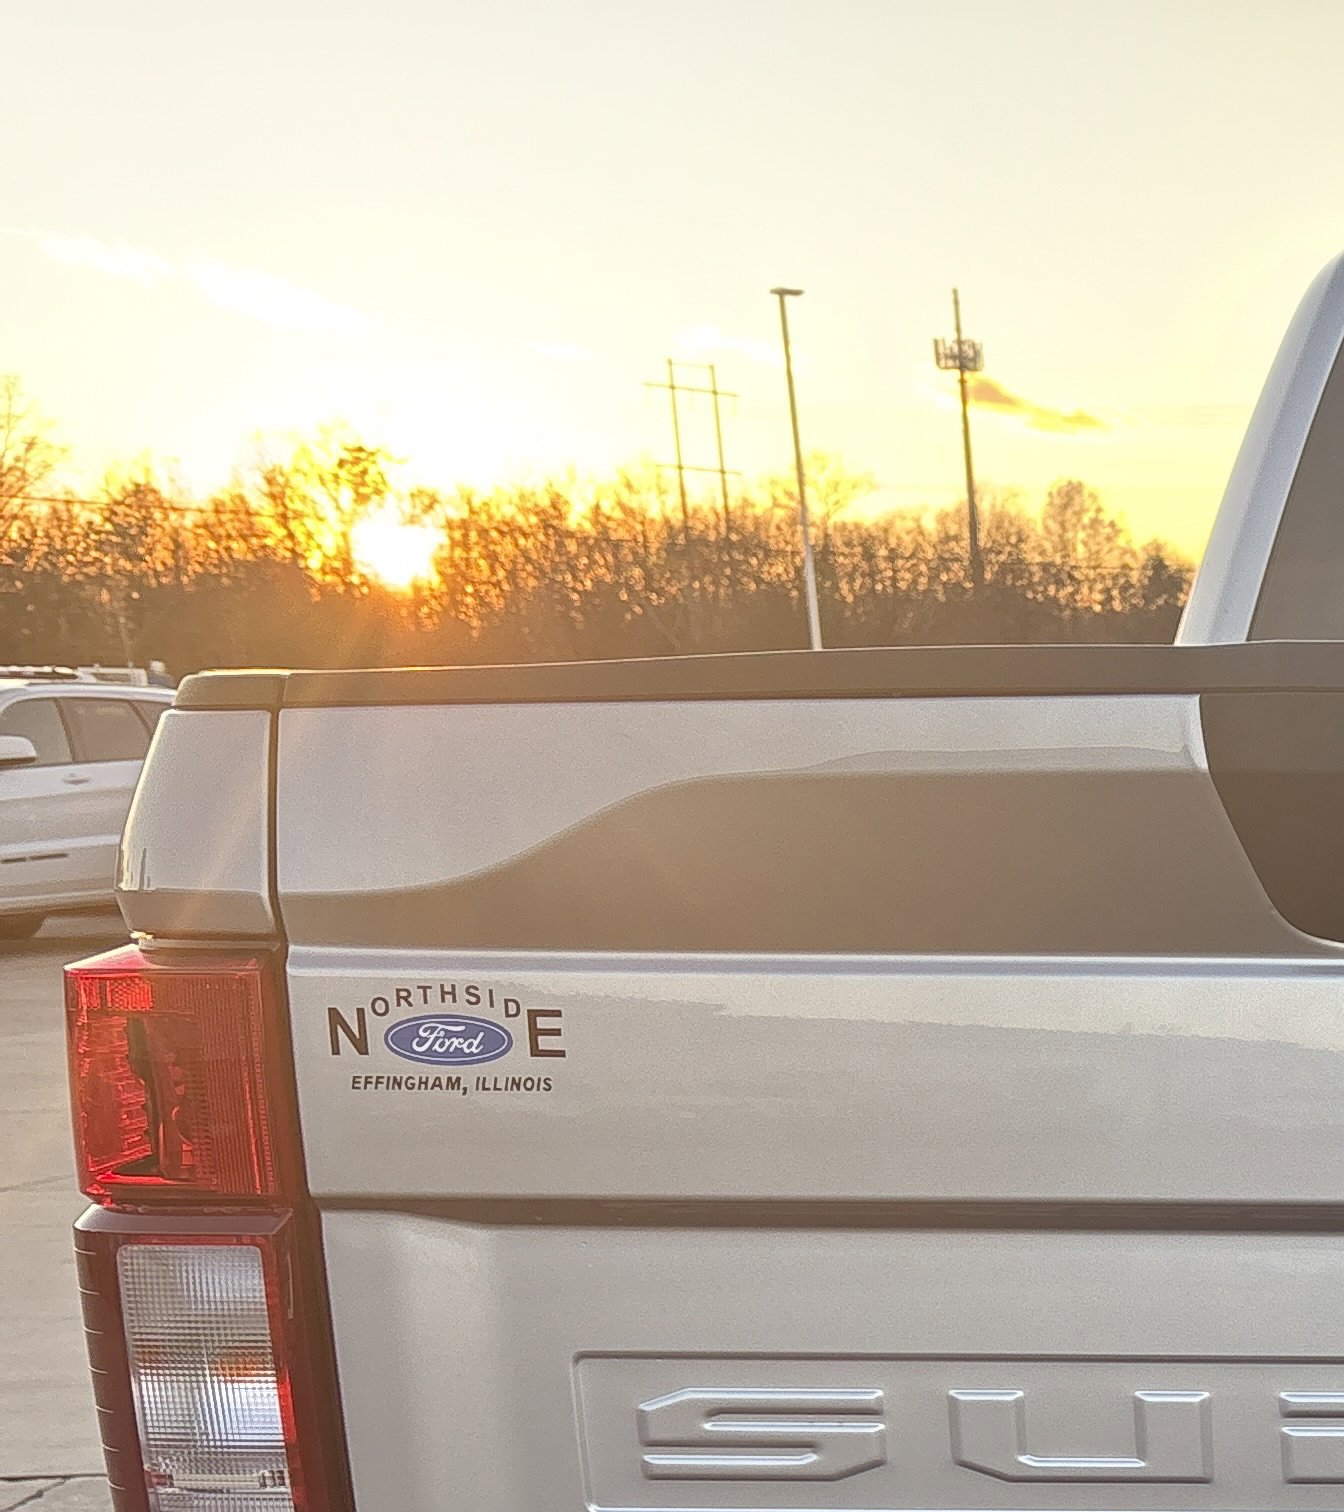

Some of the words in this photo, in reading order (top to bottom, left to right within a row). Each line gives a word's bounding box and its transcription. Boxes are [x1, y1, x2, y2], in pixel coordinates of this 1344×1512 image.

[327, 984, 567, 1058] NORTHSIDE
[412, 1023, 484, 1054] Ford
[351, 1075, 468, 1096] EFFINGHAM,
[475, 1076, 553, 1092] ILLINOIS
